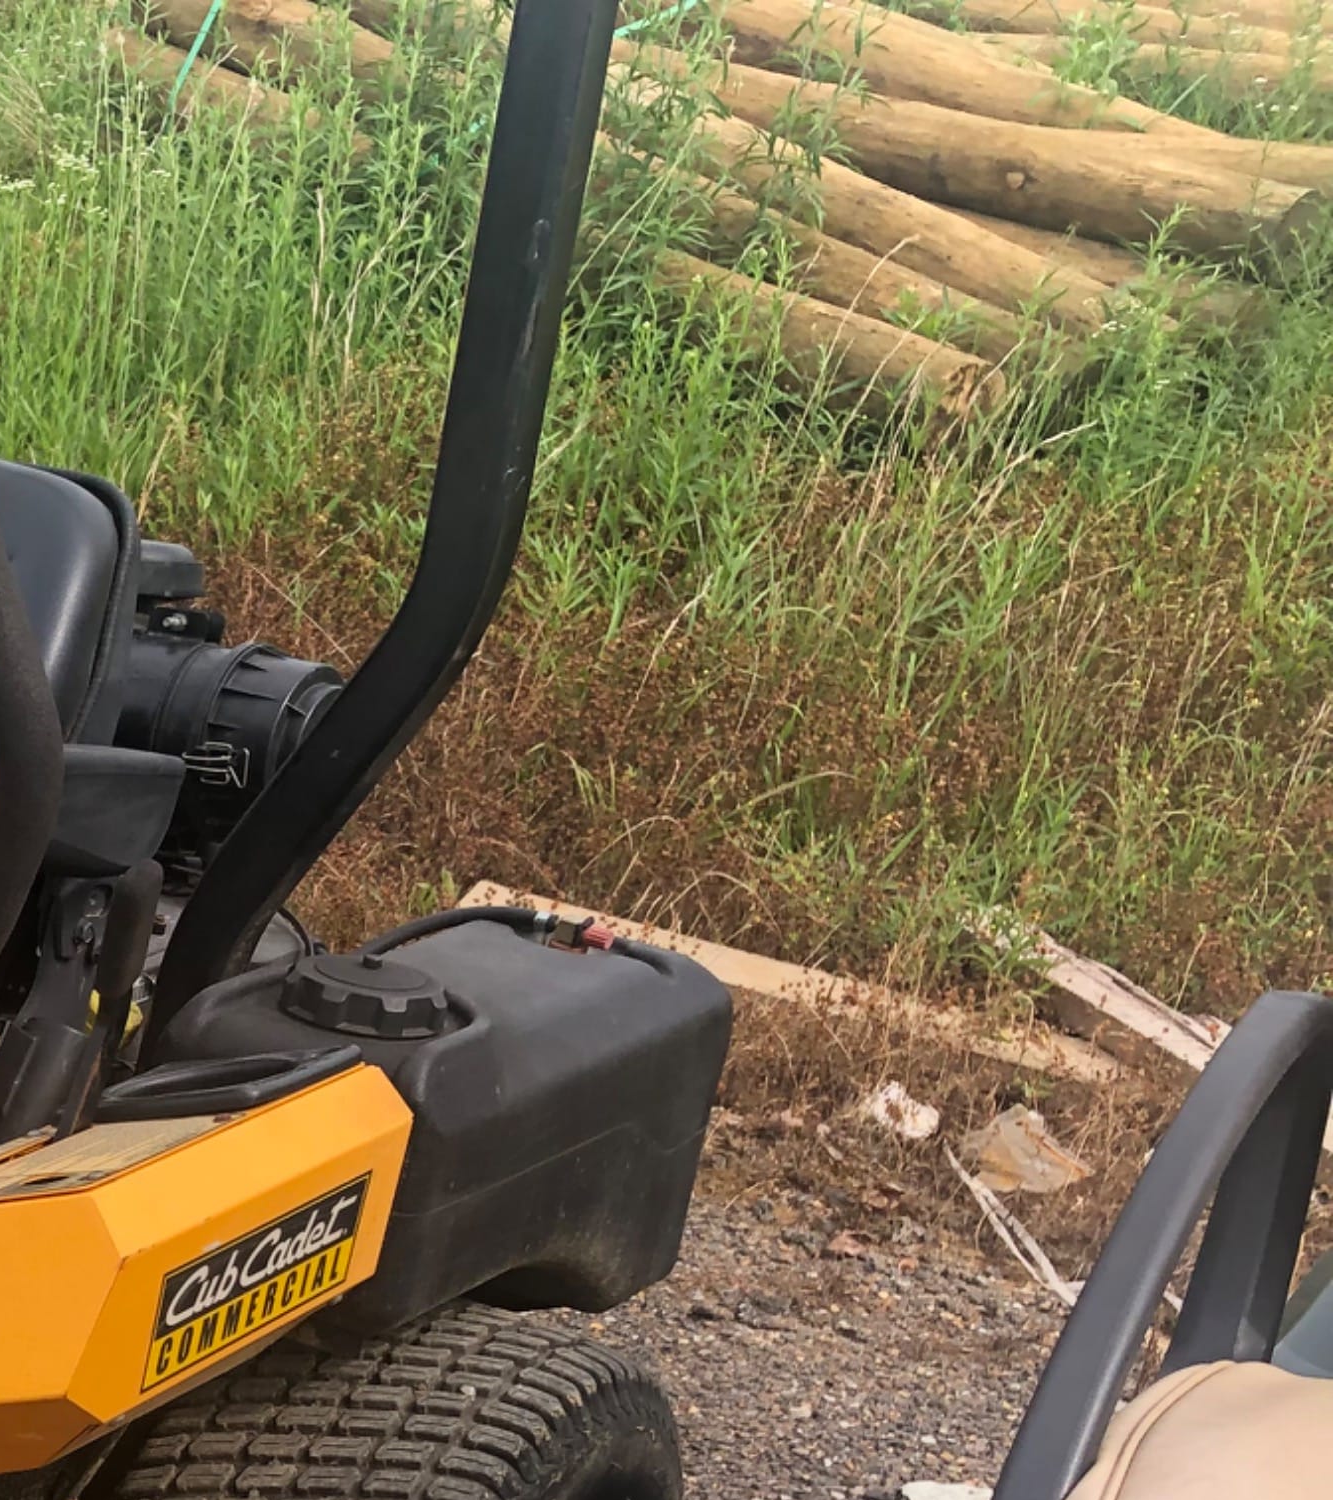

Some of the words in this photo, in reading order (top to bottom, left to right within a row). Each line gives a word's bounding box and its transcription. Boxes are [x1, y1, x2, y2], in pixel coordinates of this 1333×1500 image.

[155, 1246, 341, 1376] COMMERCIAL
[166, 1250, 239, 1326] Cub
[239, 1195, 358, 1287] Cadet
